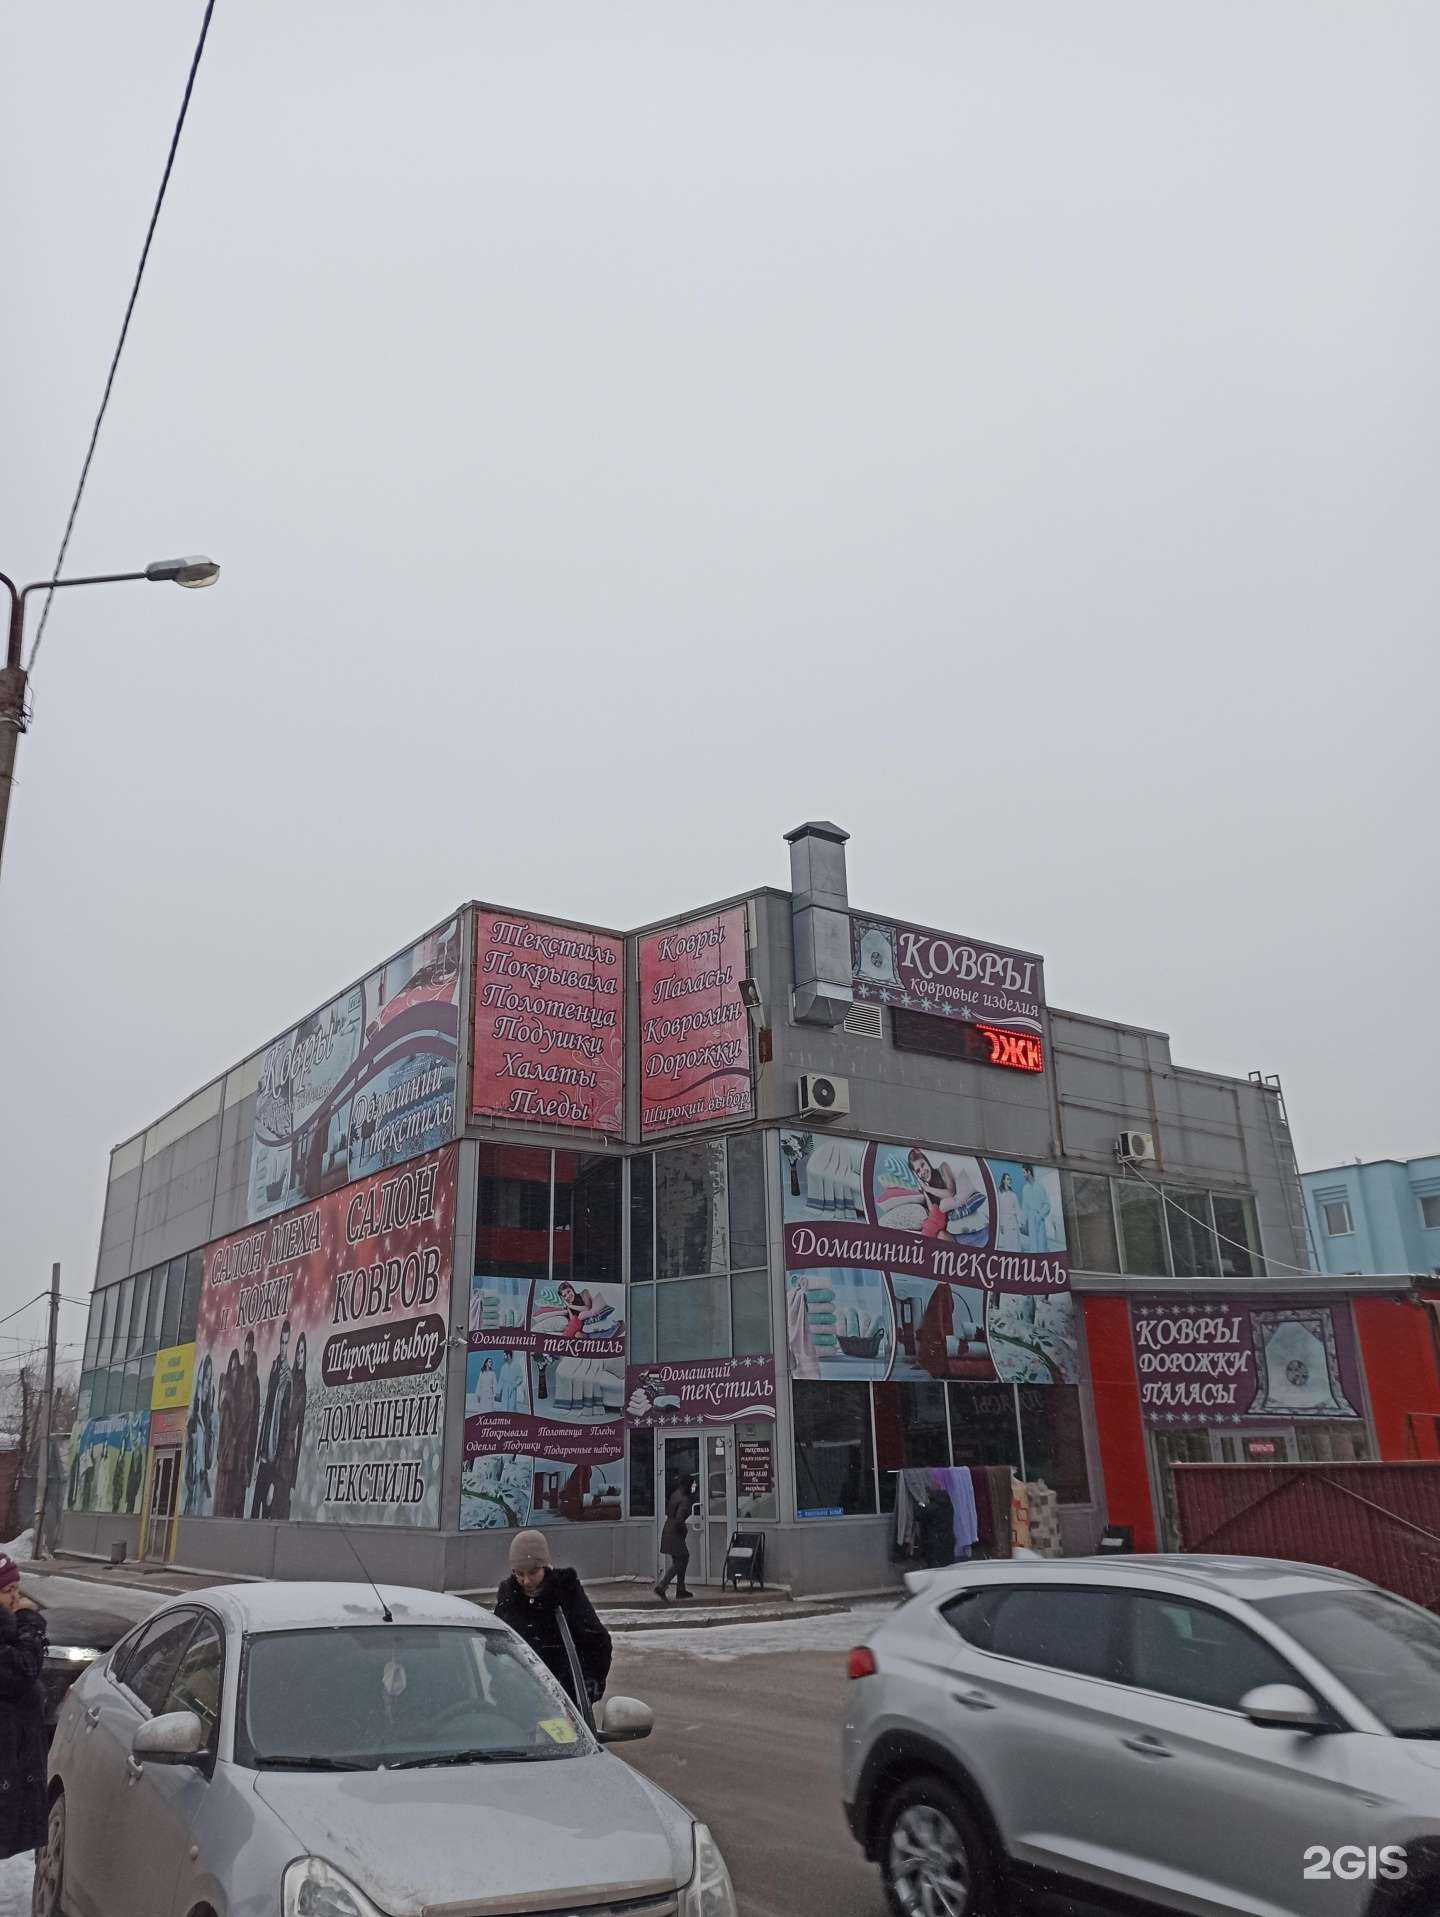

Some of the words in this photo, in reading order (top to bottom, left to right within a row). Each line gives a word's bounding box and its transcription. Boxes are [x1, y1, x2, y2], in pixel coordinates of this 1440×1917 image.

[491, 921, 617, 965] Текстиль
[657, 926, 726, 961] Ковры
[483, 951, 617, 994] Покрывала
[900, 933, 1035, 995] КОВРЫ
[652, 966, 733, 1004] Паласы
[910, 977, 979, 1003] ковровые
[983, 990, 1040, 1018] изделия
[481, 984, 617, 1029] Полотенца
[643, 1002, 742, 1044] Ковролин
[492, 1016, 604, 1058] Подушки
[496, 1053, 598, 1098] Халаты
[645, 1039, 742, 1081] Дорожки
[352, 1059, 445, 1130] Домашний
[508, 1089, 589, 1121] Пледы
[643, 1098, 706, 1125] Широкий
[708, 1087, 751, 1112] выбор
[369, 1098, 452, 1156] текстиль
[346, 1162, 439, 1246] САЛОН
[210, 1231, 266, 1287] САЛОН
[267, 1208, 321, 1267] МЕХА
[791, 1228, 925, 1265] Домашний
[931, 1249, 1067, 1289] текстиль
[235, 1272, 293, 1328] КОЖИ
[333, 1246, 440, 1325] КОВРОВ
[327, 1332, 391, 1381] Широкий
[393, 1320, 440, 1369] выбор
[471, 1330, 537, 1346] Домашний
[543, 1337, 623, 1357] текстиль
[1136, 1317, 1242, 1350] КОВРЫ
[660, 1362, 732, 1382] Домашний
[1140, 1350, 1251, 1377] ДОРОЖКИ
[681, 1379, 774, 1405] текстиль
[1141, 1381, 1238, 1406] ПАЛАСЫ
[318, 1382, 442, 1450] ДОМАШНИЙ
[475, 1416, 512, 1426] Халаты
[480, 1427, 529, 1441] Покрывала
[537, 1426, 583, 1438] Полотенца
[590, 1426, 617, 1436] Пледы
[466, 1441, 497, 1452] Одеяла
[502, 1440, 542, 1453] Подушки
[543, 1444, 593, 1457] Подарочные
[594, 1443, 623, 1457] наборы
[324, 1461, 424, 1504] ТЕКСТИЛЬ
